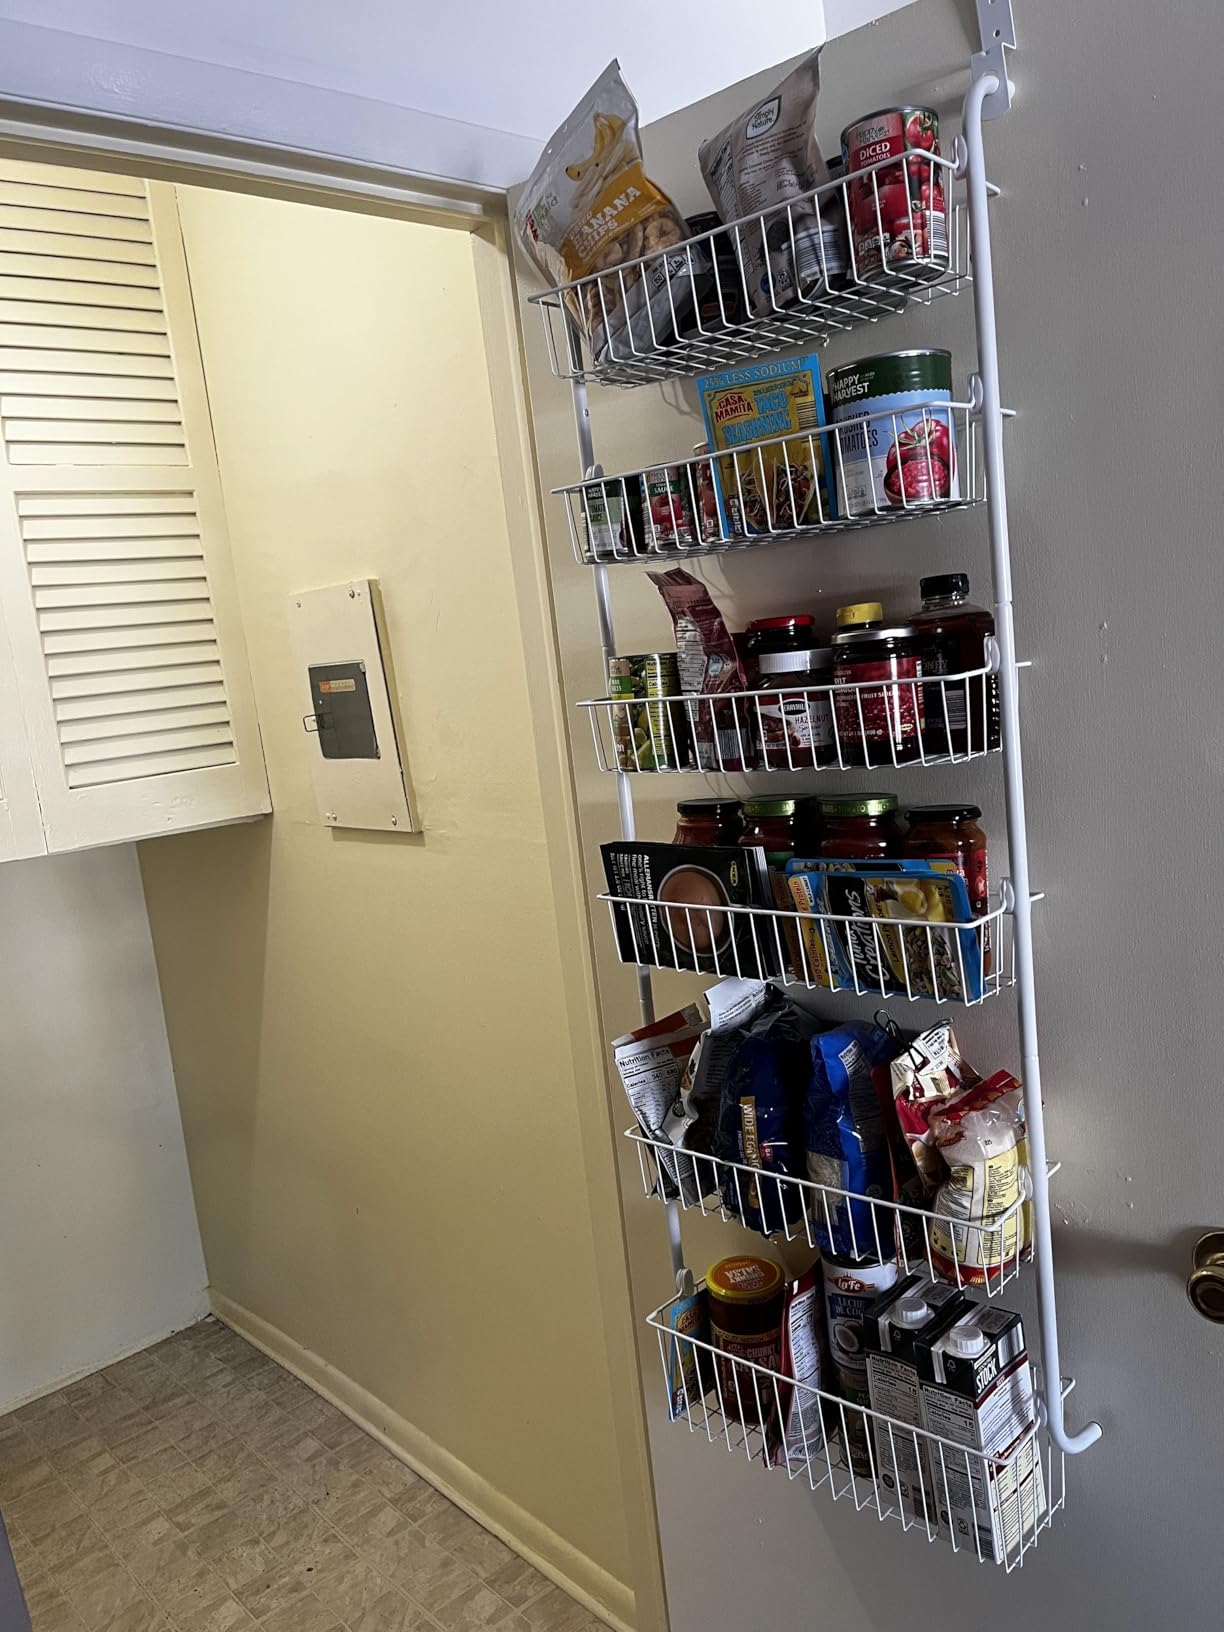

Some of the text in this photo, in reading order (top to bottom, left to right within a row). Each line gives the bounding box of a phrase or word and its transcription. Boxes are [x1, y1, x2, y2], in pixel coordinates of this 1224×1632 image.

[860, 141, 891, 160] DICED
[860, 152, 891, 167] TOMATOES
[572, 186, 641, 251] BANANA
[577, 219, 618, 259] CHIPS
[704, 377, 724, 389] 25%
[725, 370, 752, 385] LESS
[832, 374, 860, 391] HAPPY
[718, 393, 746, 411] CASA
[753, 390, 789, 415] TACO
[832, 382, 870, 402] HARVEST
[714, 402, 754, 423] MAMITA
[721, 411, 793, 447] SEASONING
[838, 429, 879, 455] OMATOES
[795, 713, 829, 725] HAZELNUT
[643, 854, 658, 923] ALLEMANSRTTEN
[884, 931, 900, 963] Lemon
[619, 1048, 671, 1068] Nutrition Facts
[626, 1079, 647, 1088] Calories
[743, 1104, 755, 1134] WIDE
[871, 1355, 916, 1376] Nutrition Facts
[976, 1357, 998, 1393] STOCK
[872, 1375, 897, 1387] Calories
[924, 1387, 973, 1408] Nutrition Facts
[927, 1408, 952, 1421] Calories
